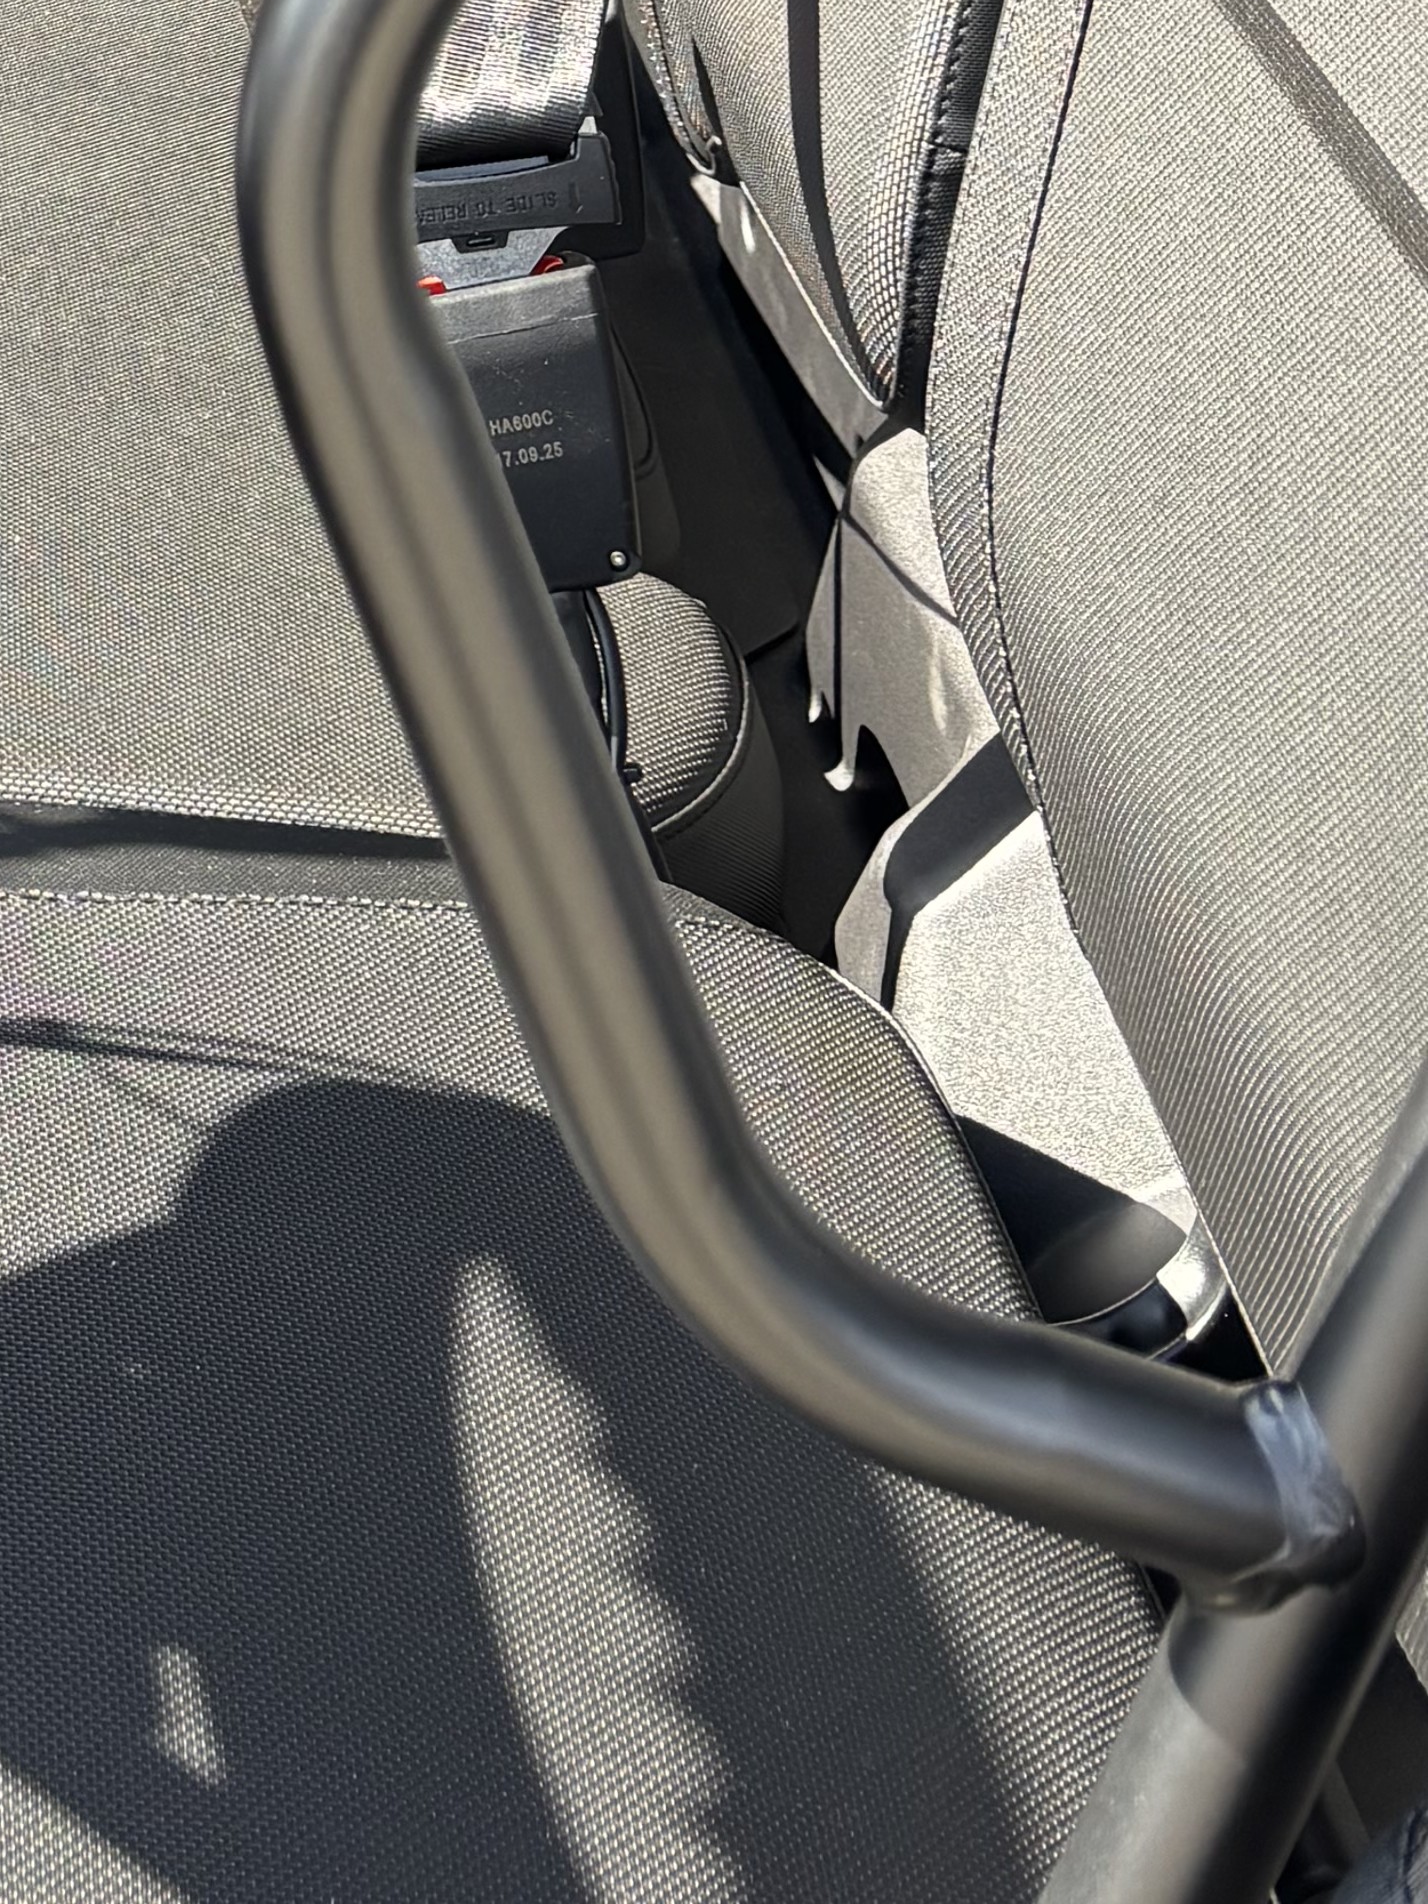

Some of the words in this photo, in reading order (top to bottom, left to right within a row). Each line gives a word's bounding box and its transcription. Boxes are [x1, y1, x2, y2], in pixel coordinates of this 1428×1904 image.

[471, 199, 498, 218] TO
[505, 191, 558, 214] SLIDE
[488, 409, 554, 436] HA600C
